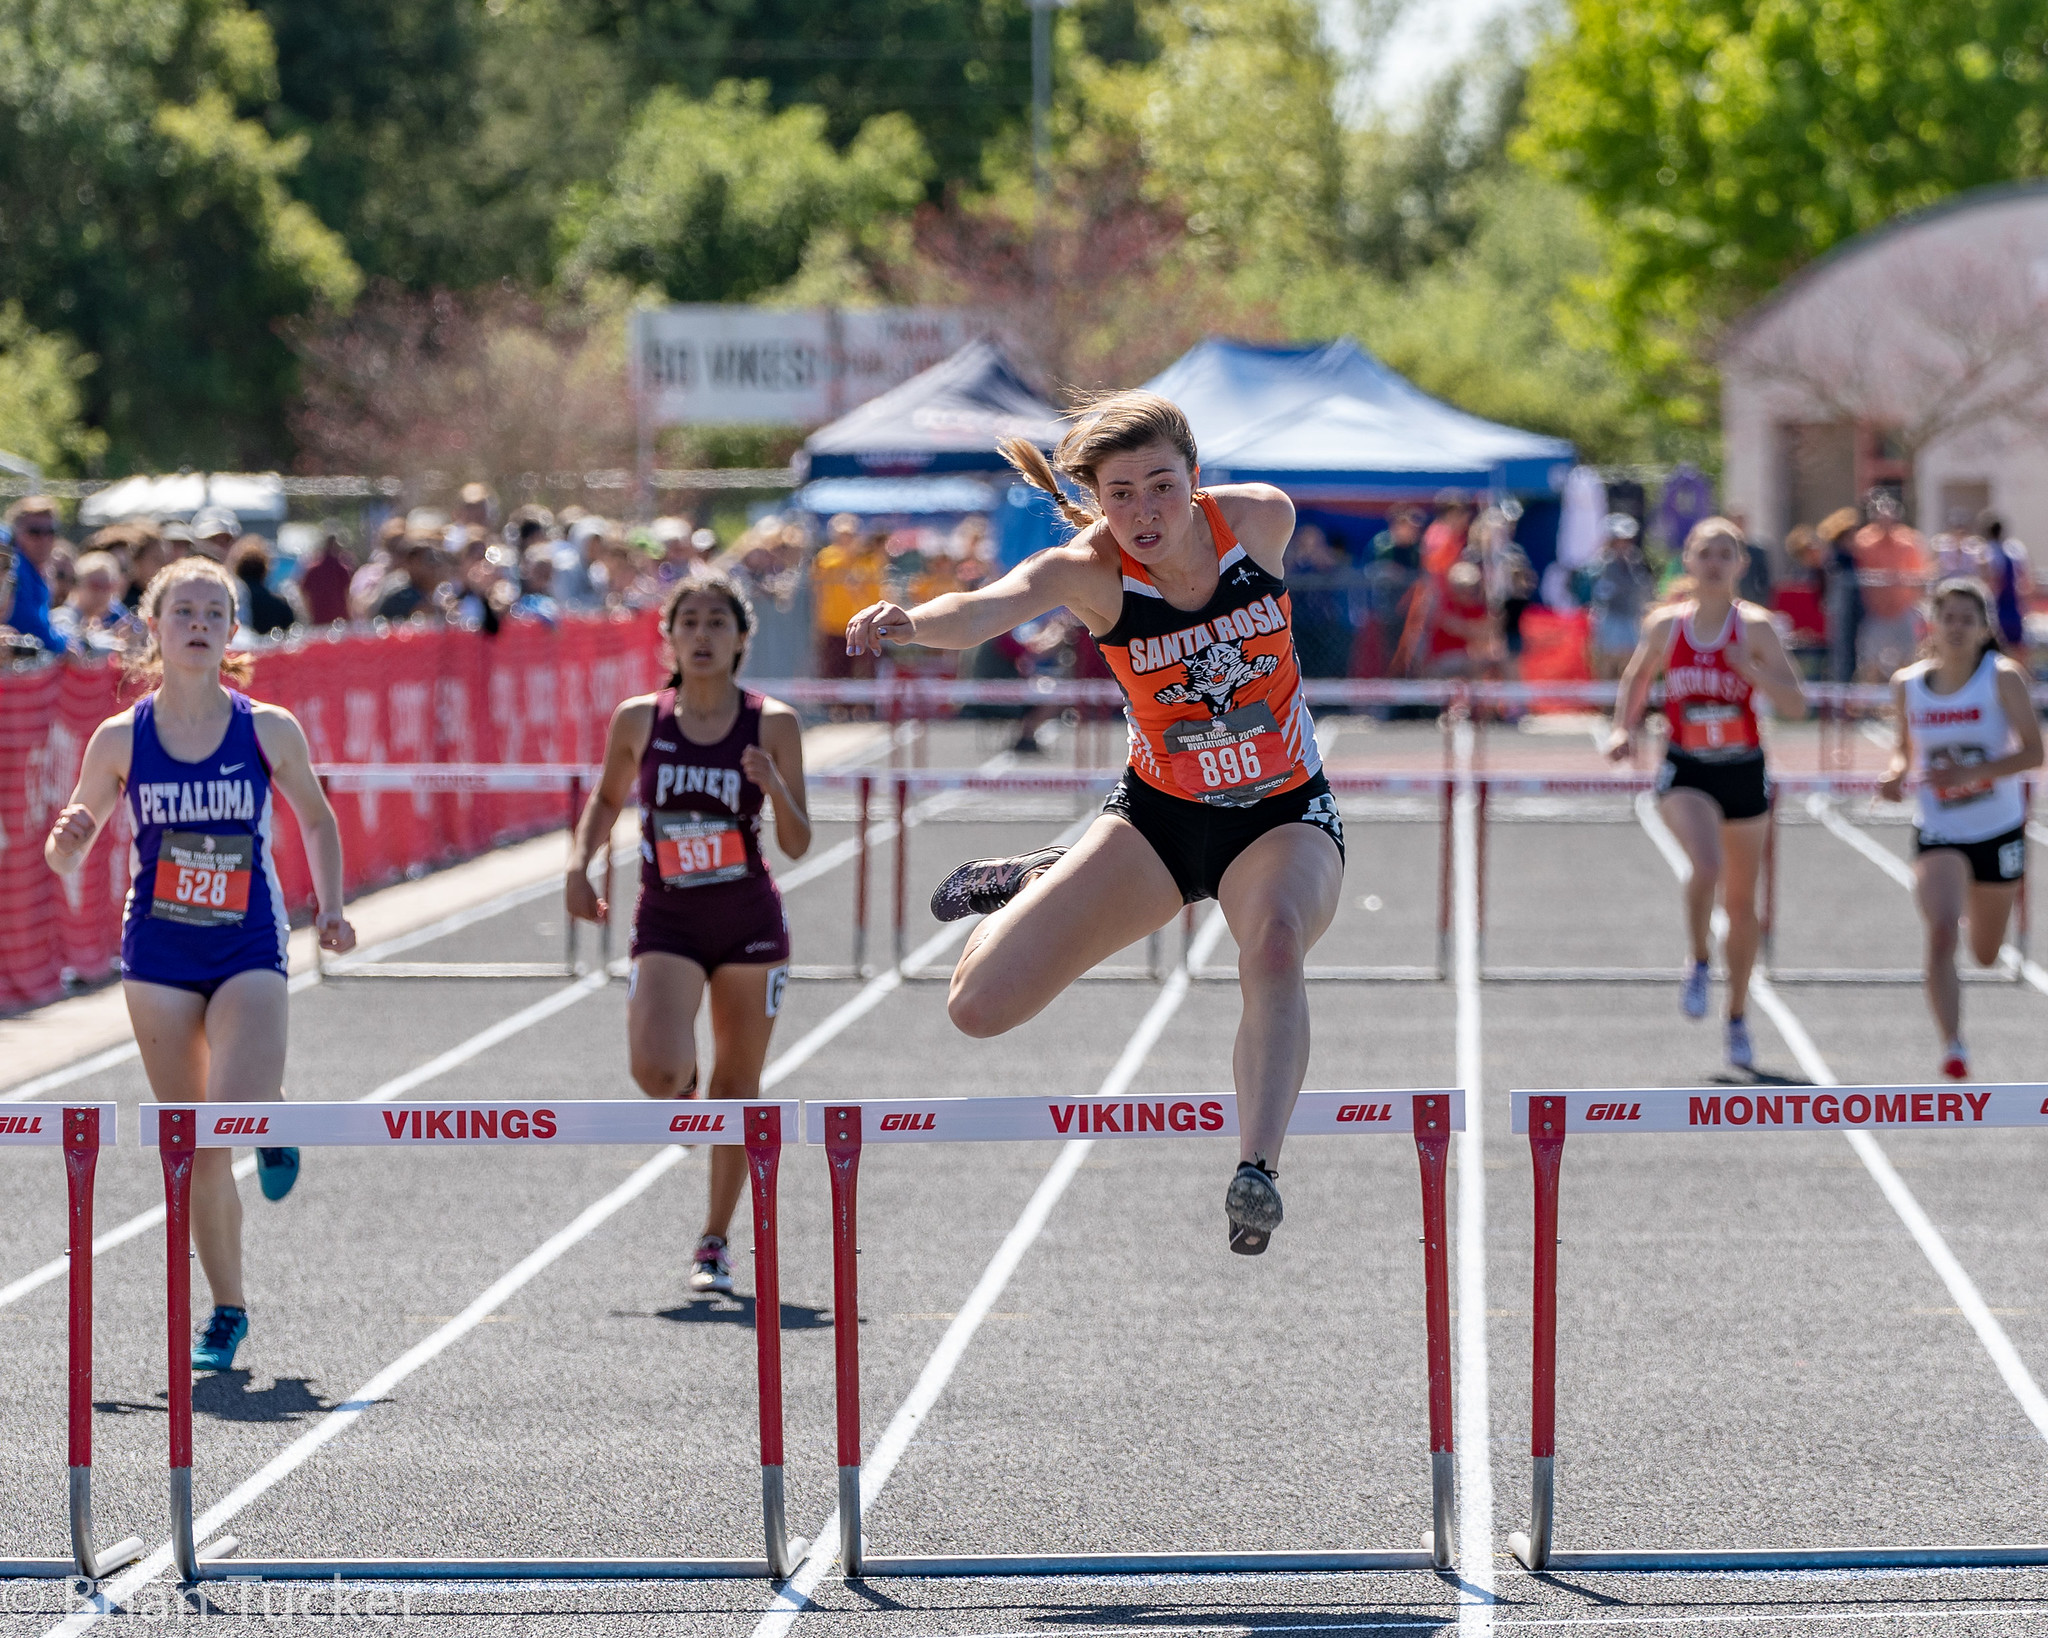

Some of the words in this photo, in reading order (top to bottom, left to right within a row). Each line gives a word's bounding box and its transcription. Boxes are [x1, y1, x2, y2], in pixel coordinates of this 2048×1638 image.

[1128, 622, 1214, 676] SANTA
[1211, 593, 1288, 643] ROSA
[1198, 741, 1262, 787] 896
[138, 779, 255, 825] PETALUMA
[655, 763, 742, 814] PINER
[677, 836, 722, 873] 597
[176, 868, 228, 906] 528
[214, 1117, 270, 1135] GILL
[382, 1109, 558, 1140] VIKINGS
[669, 1114, 726, 1132] GILL
[880, 1112, 937, 1131] GILL
[1048, 1100, 1225, 1134] VIKINGS
[1335, 1103, 1392, 1123] GILL
[1585, 1103, 1642, 1121] GILL
[1688, 1092, 1992, 1126] MONTGOMERY
